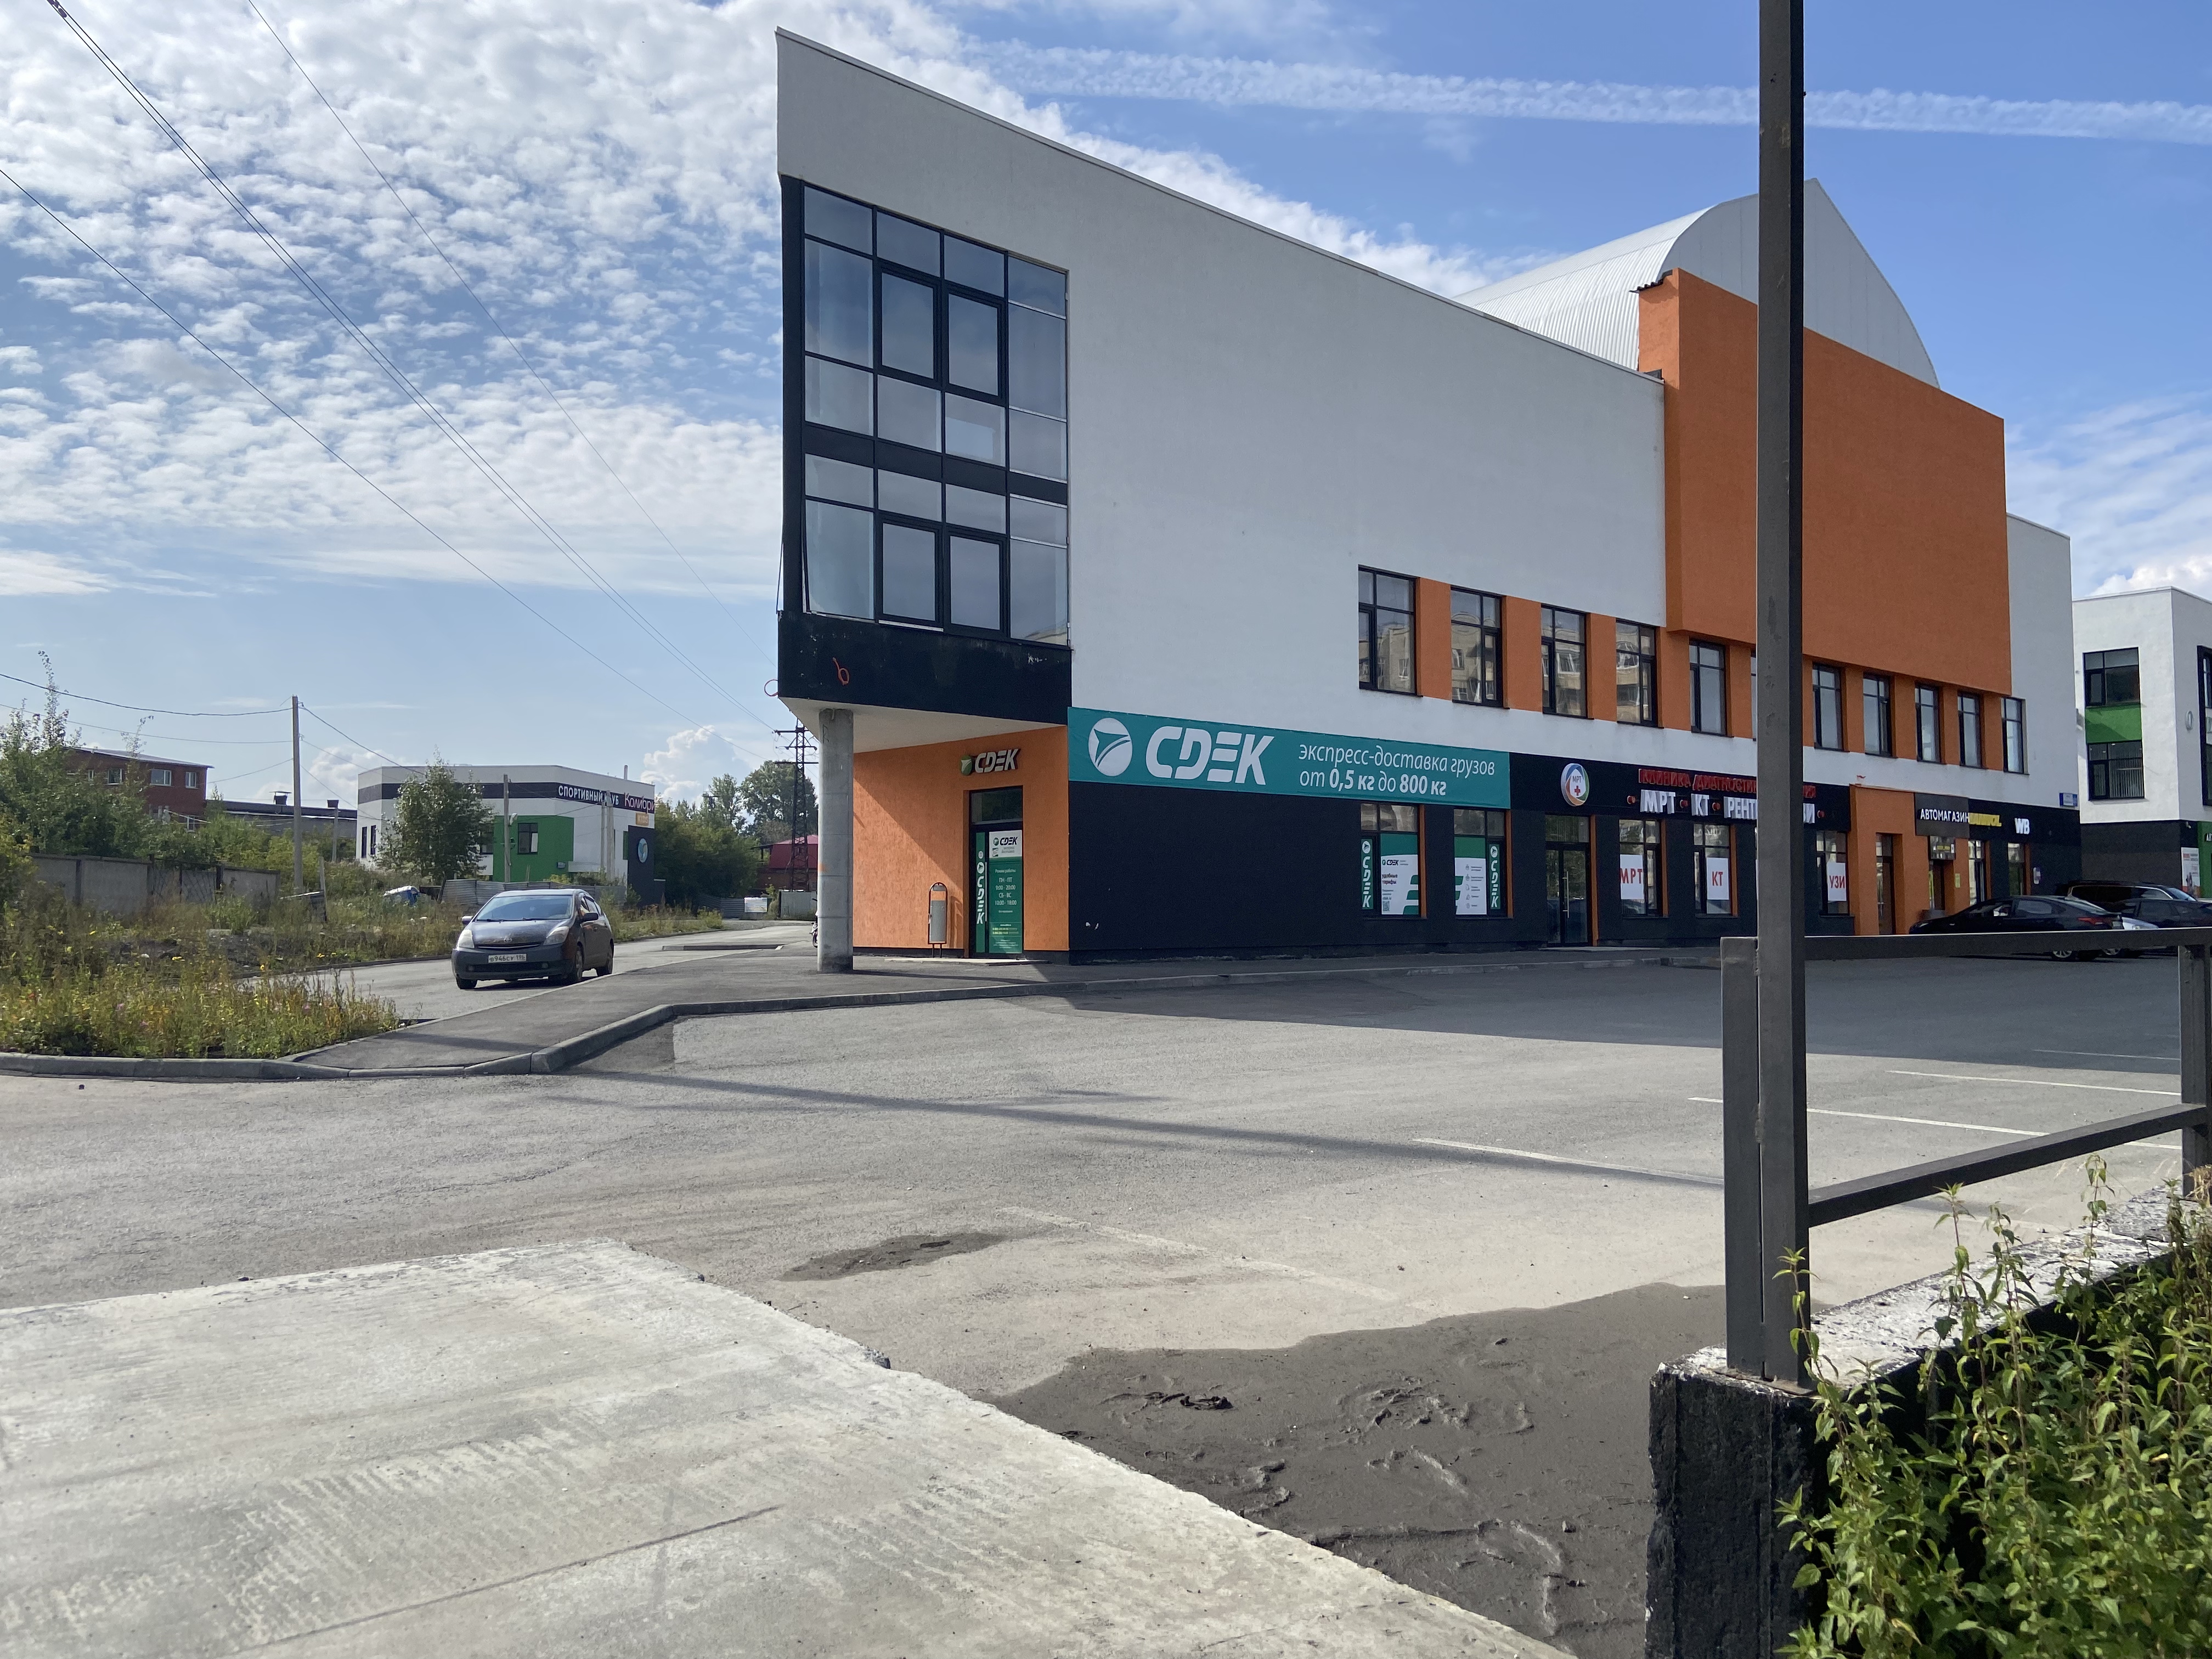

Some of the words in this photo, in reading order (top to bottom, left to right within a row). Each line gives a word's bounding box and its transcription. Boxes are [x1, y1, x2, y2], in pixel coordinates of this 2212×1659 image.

[975, 749, 1019, 773] CDEK
[1146, 726, 1275, 785] CDEK
[1299, 744, 1448, 772] экспресс-доставка
[1451, 758, 1494, 778] грузов
[1300, 770, 1325, 787] от
[1329, 769, 1354, 791] 0,5
[1358, 775, 1375, 791] кг
[1378, 770, 1396, 792] до
[1400, 774, 1428, 794] 800
[1431, 780, 1447, 795] кг
[1638, 768, 1691, 788] КЛИНИКА
[1692, 775, 1757, 794] ДИАГНОСТИ
[558, 785, 603, 803] СПОРТИВНЫЙ
[1640, 789, 1675, 814] МРТ
[1691, 793, 1709, 816] КТ
[1920, 808, 1970, 823] АВТОМАГАЗИН
[2015, 817, 2030, 834] WB
[1000, 837, 1018, 845] CDEK
[1620, 868, 1643, 884] МРТ
[1712, 871, 1723, 887] КТ
[1829, 875, 1845, 889] УЗИ
